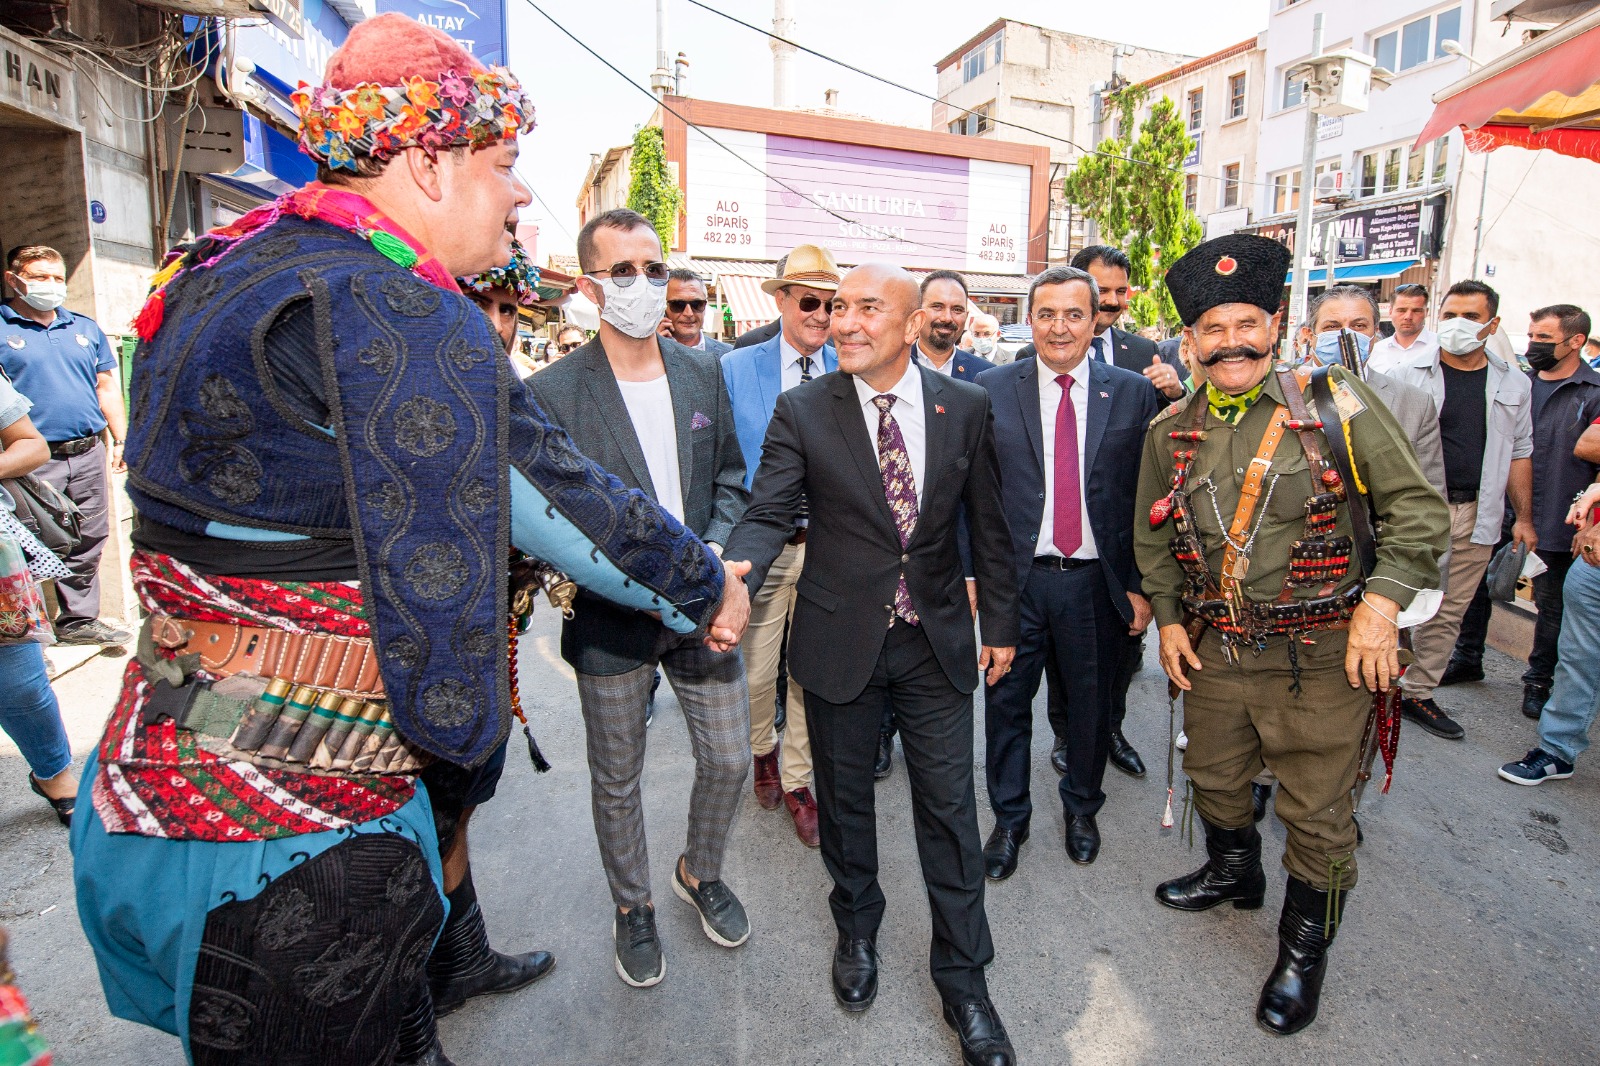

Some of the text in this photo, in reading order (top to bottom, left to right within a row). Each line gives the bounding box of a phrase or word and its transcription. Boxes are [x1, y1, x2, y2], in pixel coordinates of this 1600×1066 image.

[288, 6, 302, 34] 25
[417, 14, 464, 30] ALTAY
[6, 50, 61, 98] HAN
[716, 200, 739, 213] ALO
[706, 214, 748, 231] SİPARİŞ
[989, 224, 1006, 234] ALO
[704, 232, 751, 244] 482 29 39
[982, 235, 1014, 250] SİPARİŞ
[1311, 223, 1322, 253] &
[979, 250, 1016, 262] 482 29 39
[1406, 247, 1416, 256] 71
